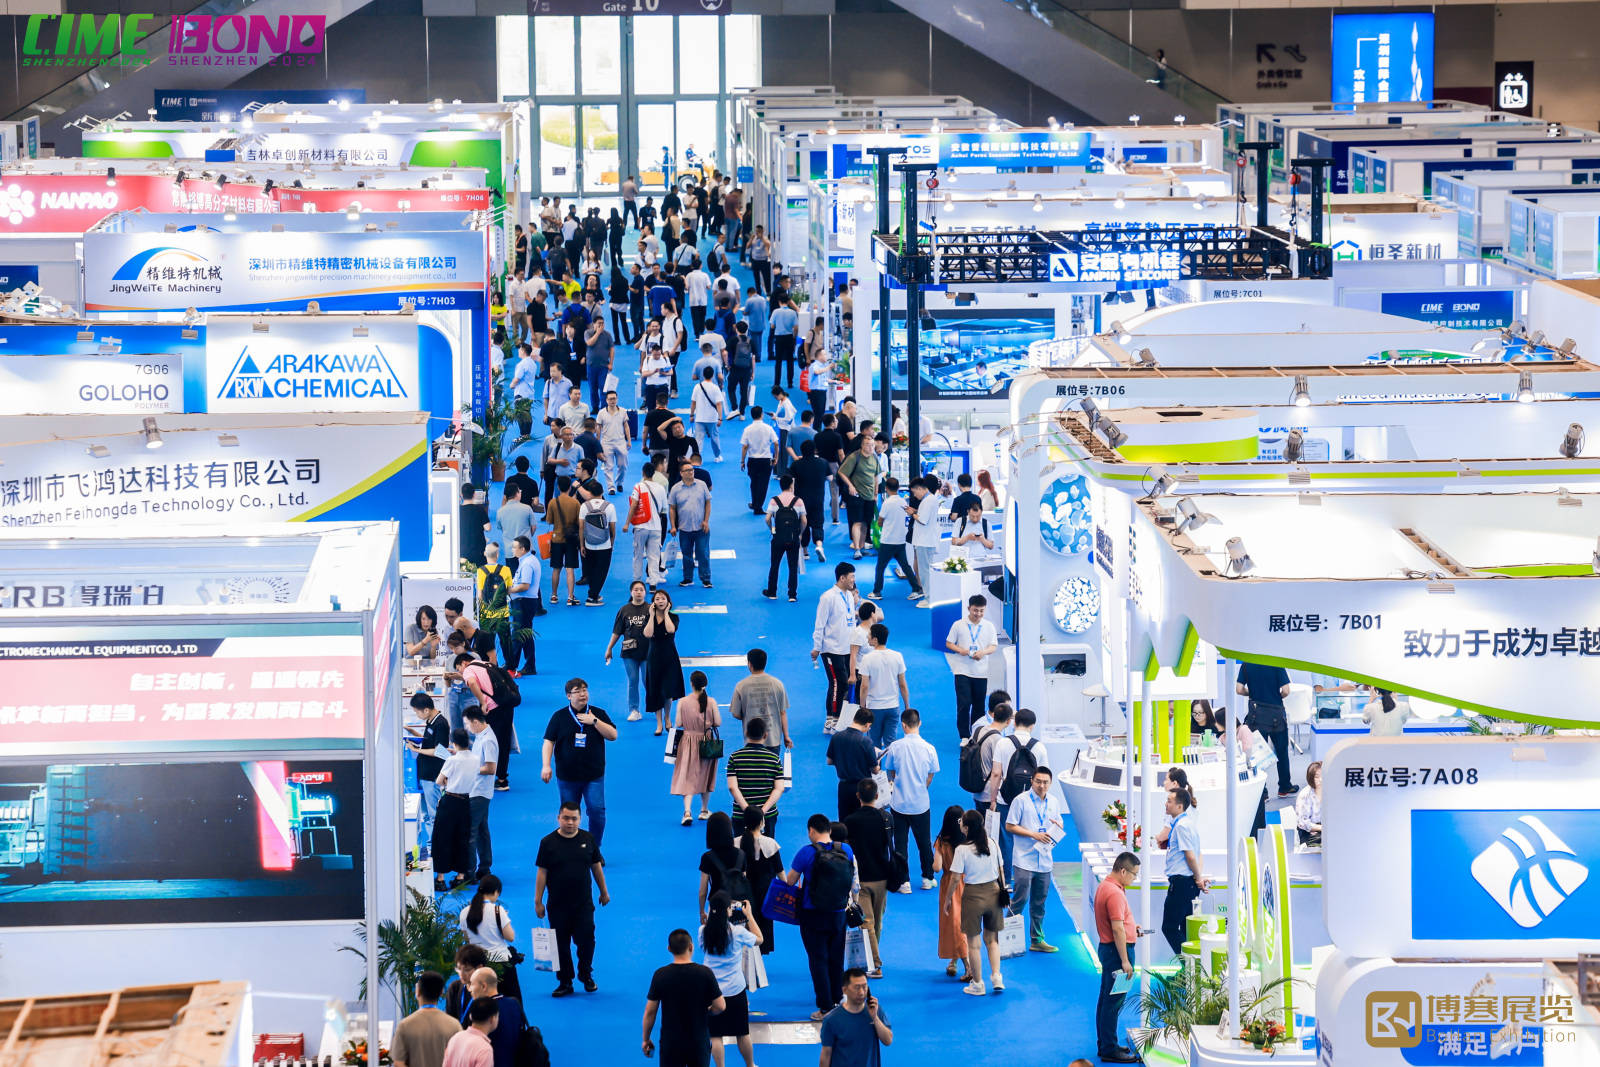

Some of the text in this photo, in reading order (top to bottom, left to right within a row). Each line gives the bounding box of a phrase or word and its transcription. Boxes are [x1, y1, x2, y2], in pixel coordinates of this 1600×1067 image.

[602, 2, 627, 12] Gate
[247, 148, 388, 162] 吉林卓创新材料有限公司
[41, 192, 118, 209] NANPAO
[249, 256, 457, 271] 深圳市精维特精密机械设备有限公司
[146, 265, 224, 281] 精维特机械
[1080, 270, 1180, 281] ANPIN SILICONE
[109, 284, 222, 294] JingWeiTe Machinery
[1213, 289, 1263, 298] 展位号:7C01
[1421, 303, 1444, 312] CIME
[135, 364, 169, 375] 7G06
[265, 354, 382, 373] ARAKAWA
[80, 383, 169, 402] GOLOHO
[274, 378, 401, 398] CHEMICAL
[1056, 384, 1126, 397] 展位号:7B06
[0, 458, 320, 507] 深圳市飞鸿达科技有限公司
[2, 508, 62, 527] Shenzhen
[65, 502, 137, 520] Feihongda
[142, 493, 235, 513] Technology
[1344, 766, 1479, 788] 展位号:7A08
